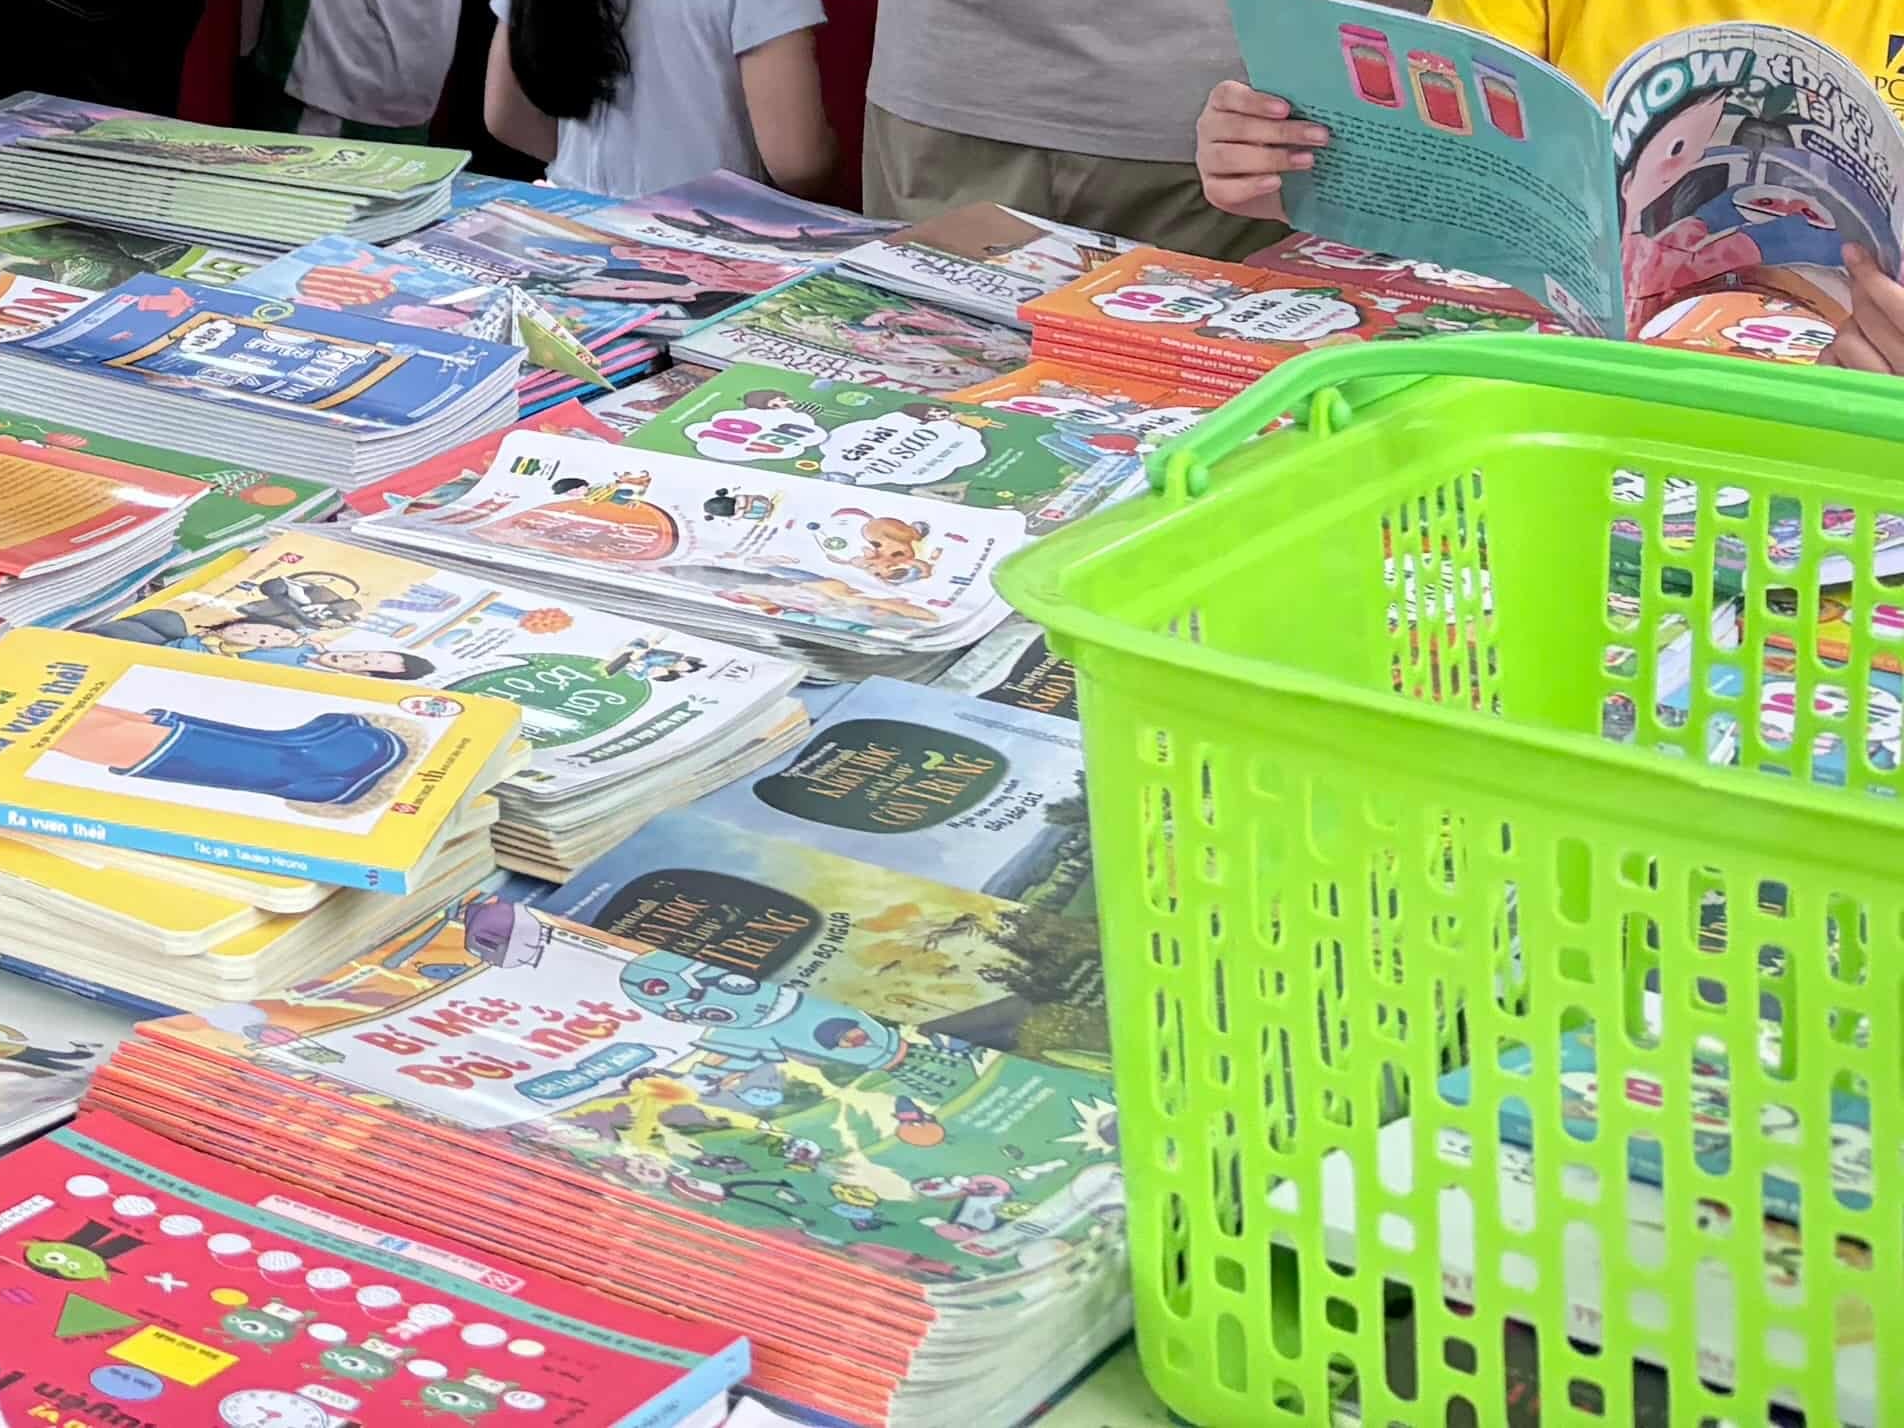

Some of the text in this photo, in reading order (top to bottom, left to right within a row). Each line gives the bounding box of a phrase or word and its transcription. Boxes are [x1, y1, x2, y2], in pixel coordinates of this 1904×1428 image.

[1613, 48, 1748, 162] WOW
[1105, 290, 1215, 320] 10 vạn
[696, 417, 817, 455] 10 vạn
[898, 429, 940, 460] sao
[0, 698, 64, 733] vườn
[563, 687, 627, 716] Con
[7, 810, 31, 829] Ra
[352, 997, 522, 1056] Bí Mật
[397, 1051, 532, 1091] Đôi
